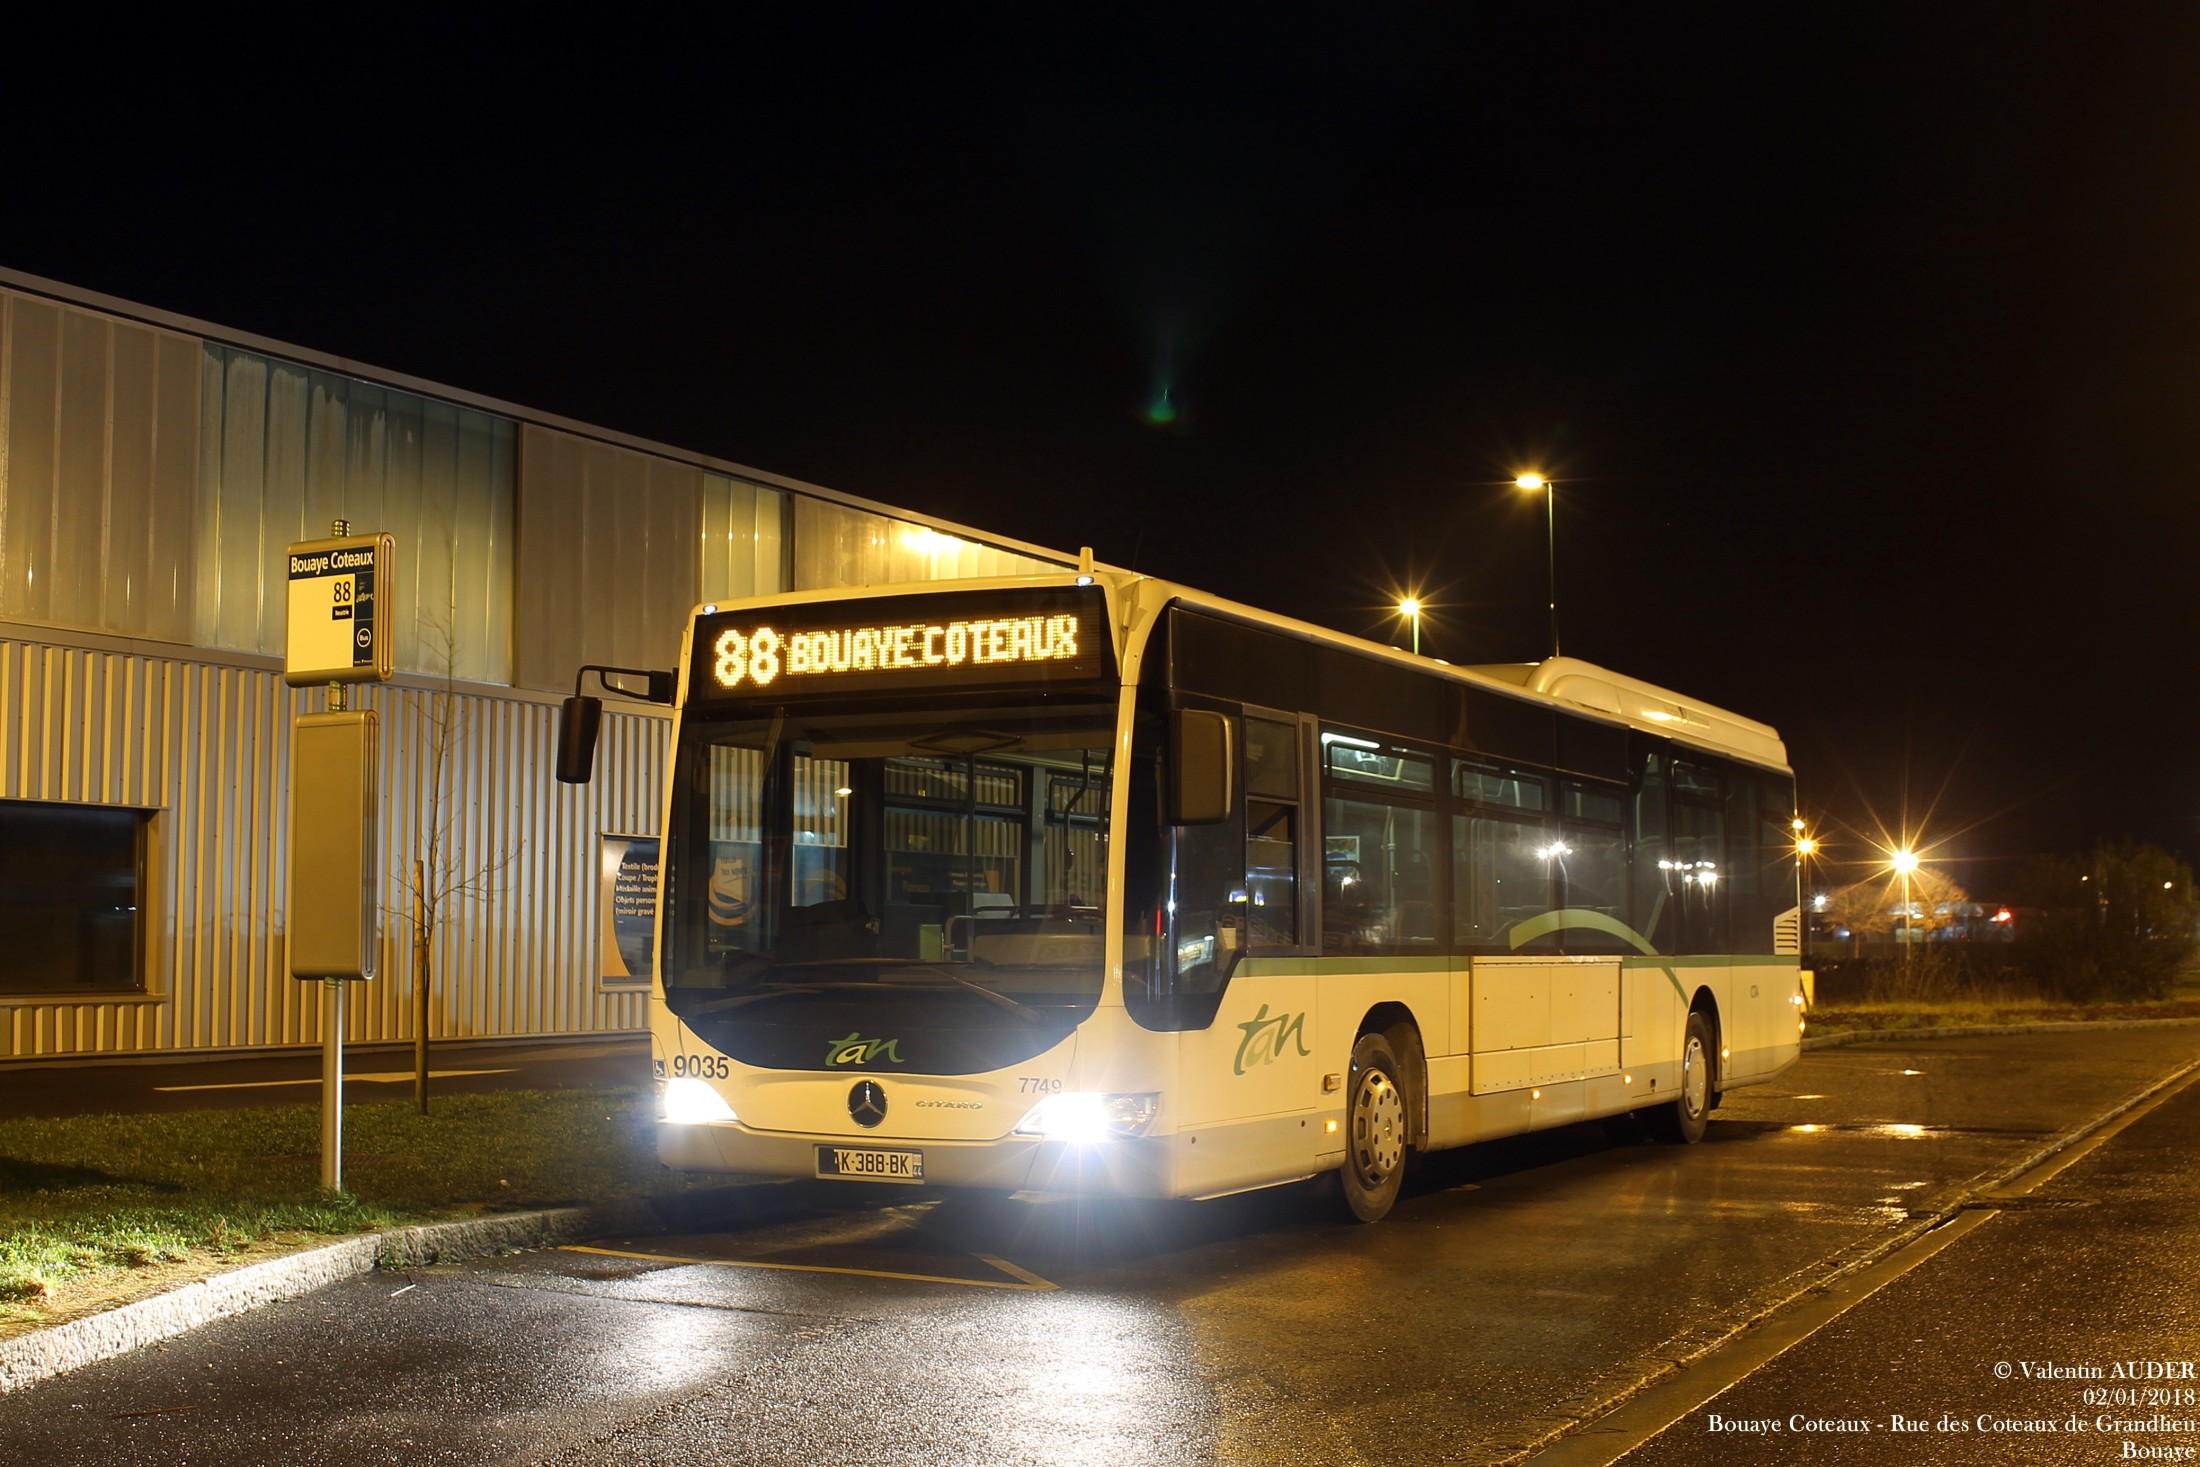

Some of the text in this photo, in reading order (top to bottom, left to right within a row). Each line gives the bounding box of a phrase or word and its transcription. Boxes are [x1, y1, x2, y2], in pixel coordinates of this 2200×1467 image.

[291, 551, 374, 575] Bouaye Coteaux
[334, 581, 351, 602] 88
[715, 614, 1078, 689] 88 BOUAYE COTEAUX
[622, 862, 640, 870] Textile
[825, 1033, 905, 1067] tan
[1234, 1004, 1311, 1076] tan
[674, 1055, 729, 1080] 9035
[1019, 1077, 1062, 1094] 7749
[915, 1099, 983, 1110] CITARO
